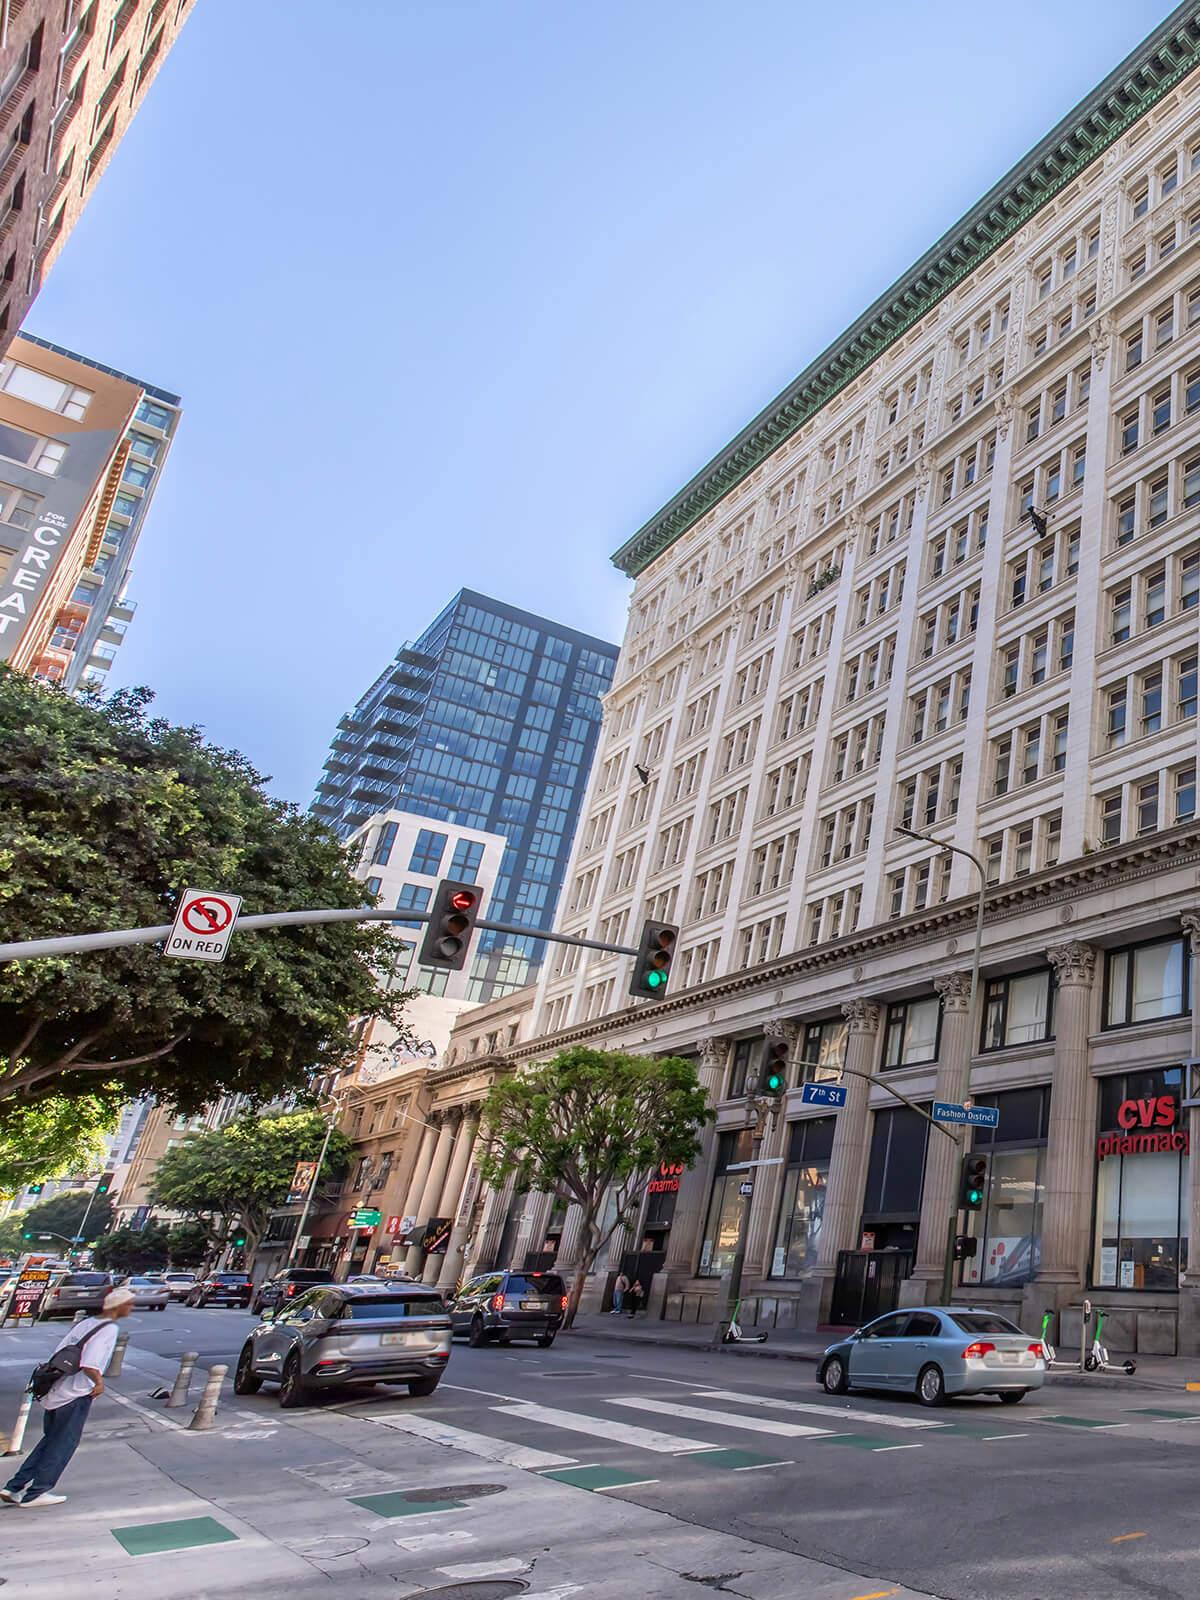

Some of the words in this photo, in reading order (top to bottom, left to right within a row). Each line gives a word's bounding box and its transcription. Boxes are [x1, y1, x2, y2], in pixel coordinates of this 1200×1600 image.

[39, 515, 69, 529] LEASE
[46, 511, 66, 522] FOR
[172, 938, 193, 950] ON
[195, 940, 223, 954] RED
[809, 1087, 827, 1101] 7th
[828, 1089, 841, 1103] St
[937, 1106, 967, 1119] Fashion
[967, 1111, 995, 1123] District
[1117, 1095, 1177, 1130] CVS
[18, 1301, 32, 1313] 12
